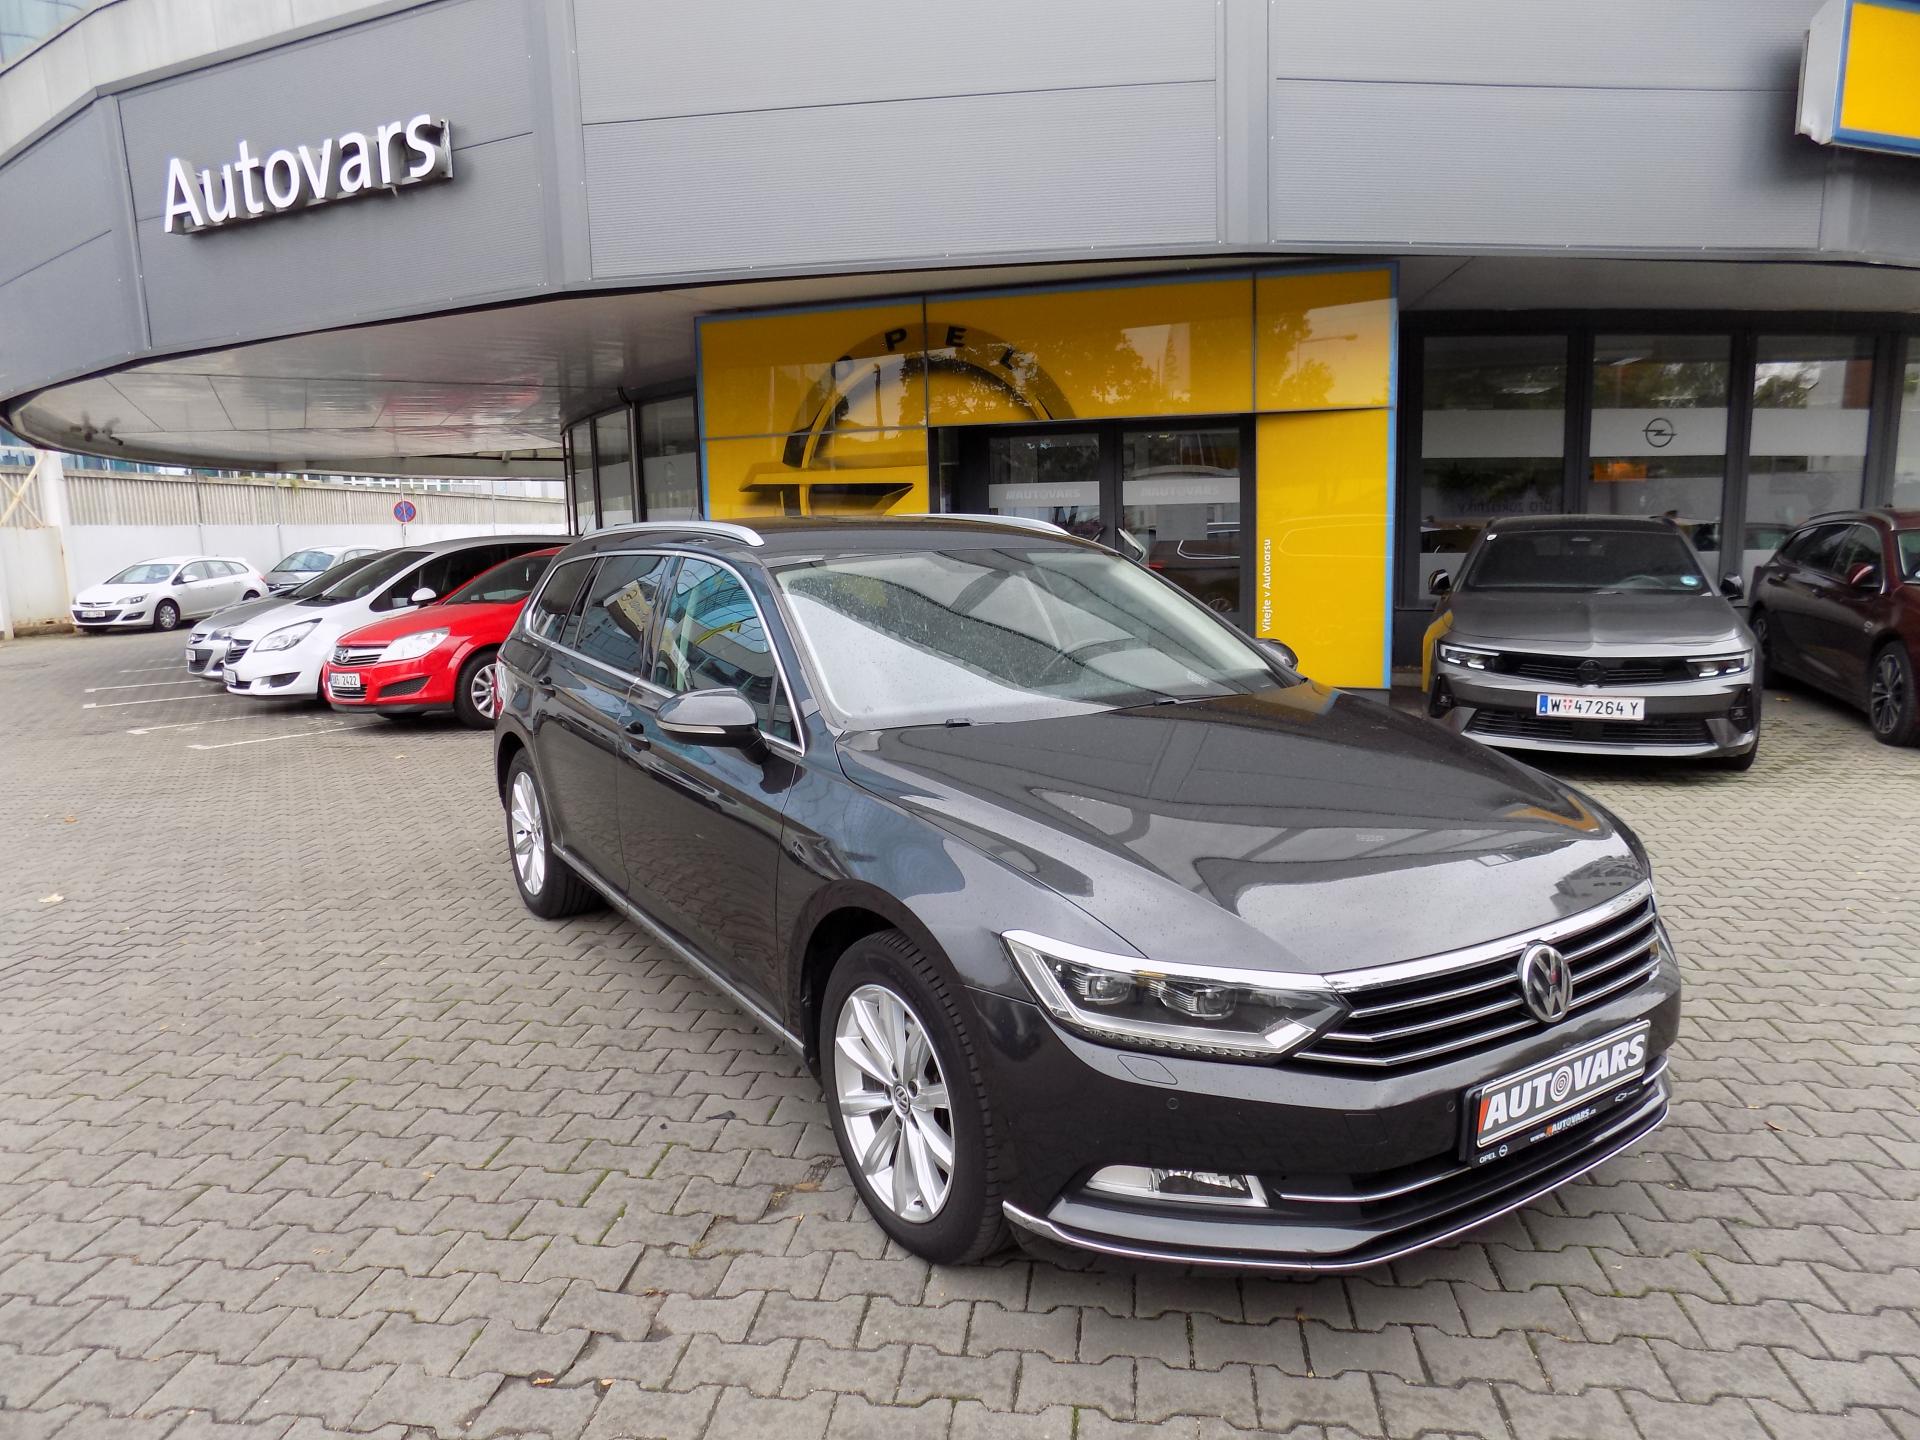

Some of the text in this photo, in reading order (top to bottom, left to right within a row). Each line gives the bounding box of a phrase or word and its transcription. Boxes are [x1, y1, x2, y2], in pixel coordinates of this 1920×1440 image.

[164, 113, 436, 233] Autovars
[342, 675, 357, 686] 2422
[1551, 698, 1562, 712] W
[1574, 700, 1624, 715] 47264
[1630, 702, 1639, 715] Y
[1483, 1034, 1646, 1131] AUTOVARS
[1479, 1152, 1497, 1164] OPEL
